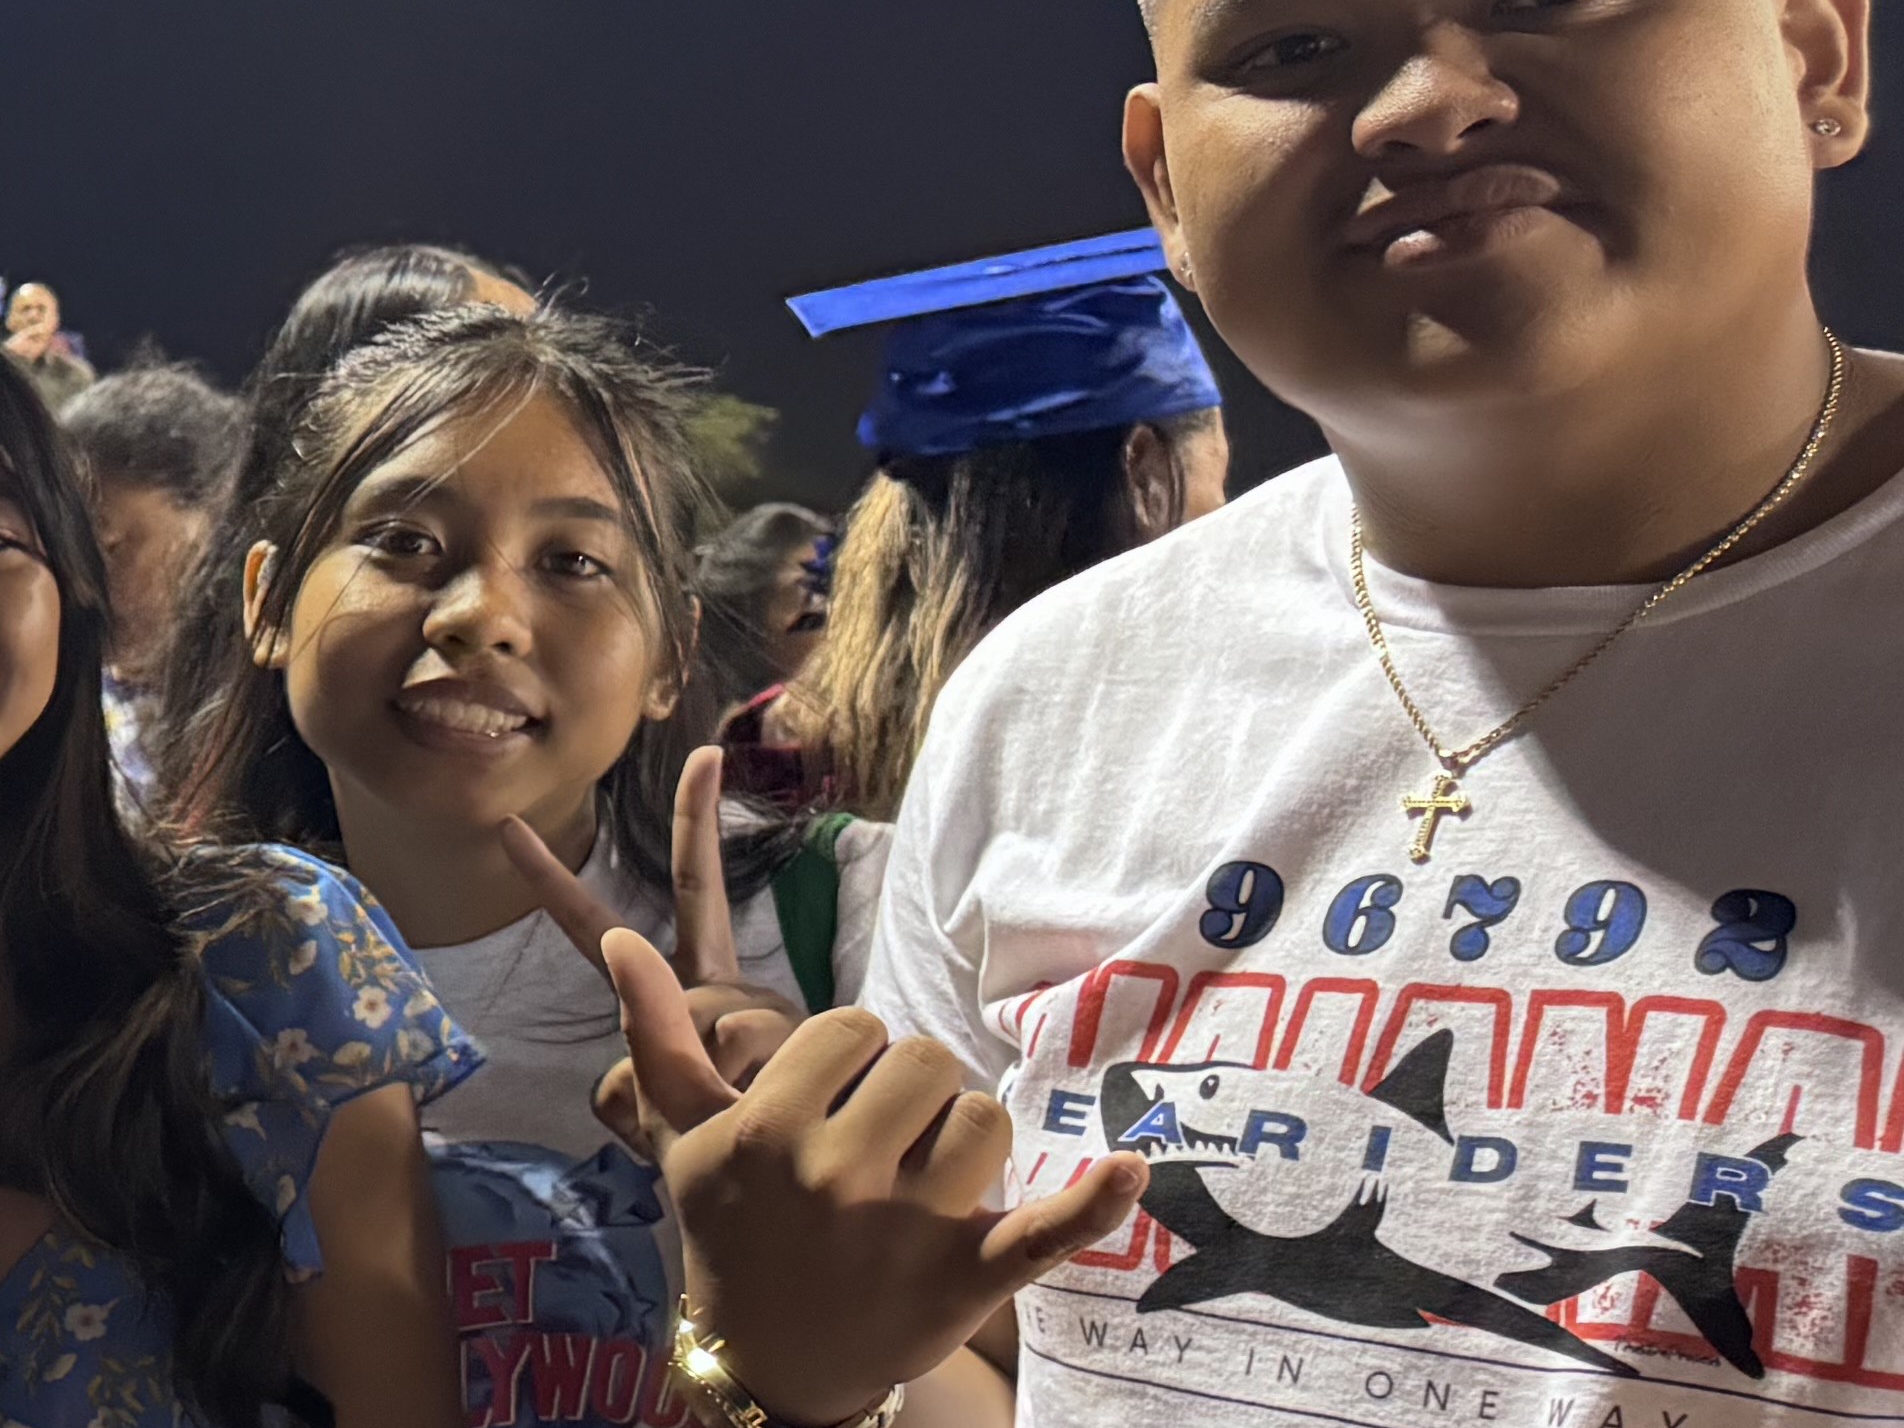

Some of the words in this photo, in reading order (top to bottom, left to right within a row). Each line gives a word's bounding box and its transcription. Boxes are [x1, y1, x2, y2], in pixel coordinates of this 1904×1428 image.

[1199, 860, 1796, 982] 96792
[1041, 1088, 1904, 1233] EARIDERS
[1079, 1317, 1192, 1364] WAY
[1245, 1348, 1303, 1384] IN
[1365, 1370, 1501, 1421] ONE
